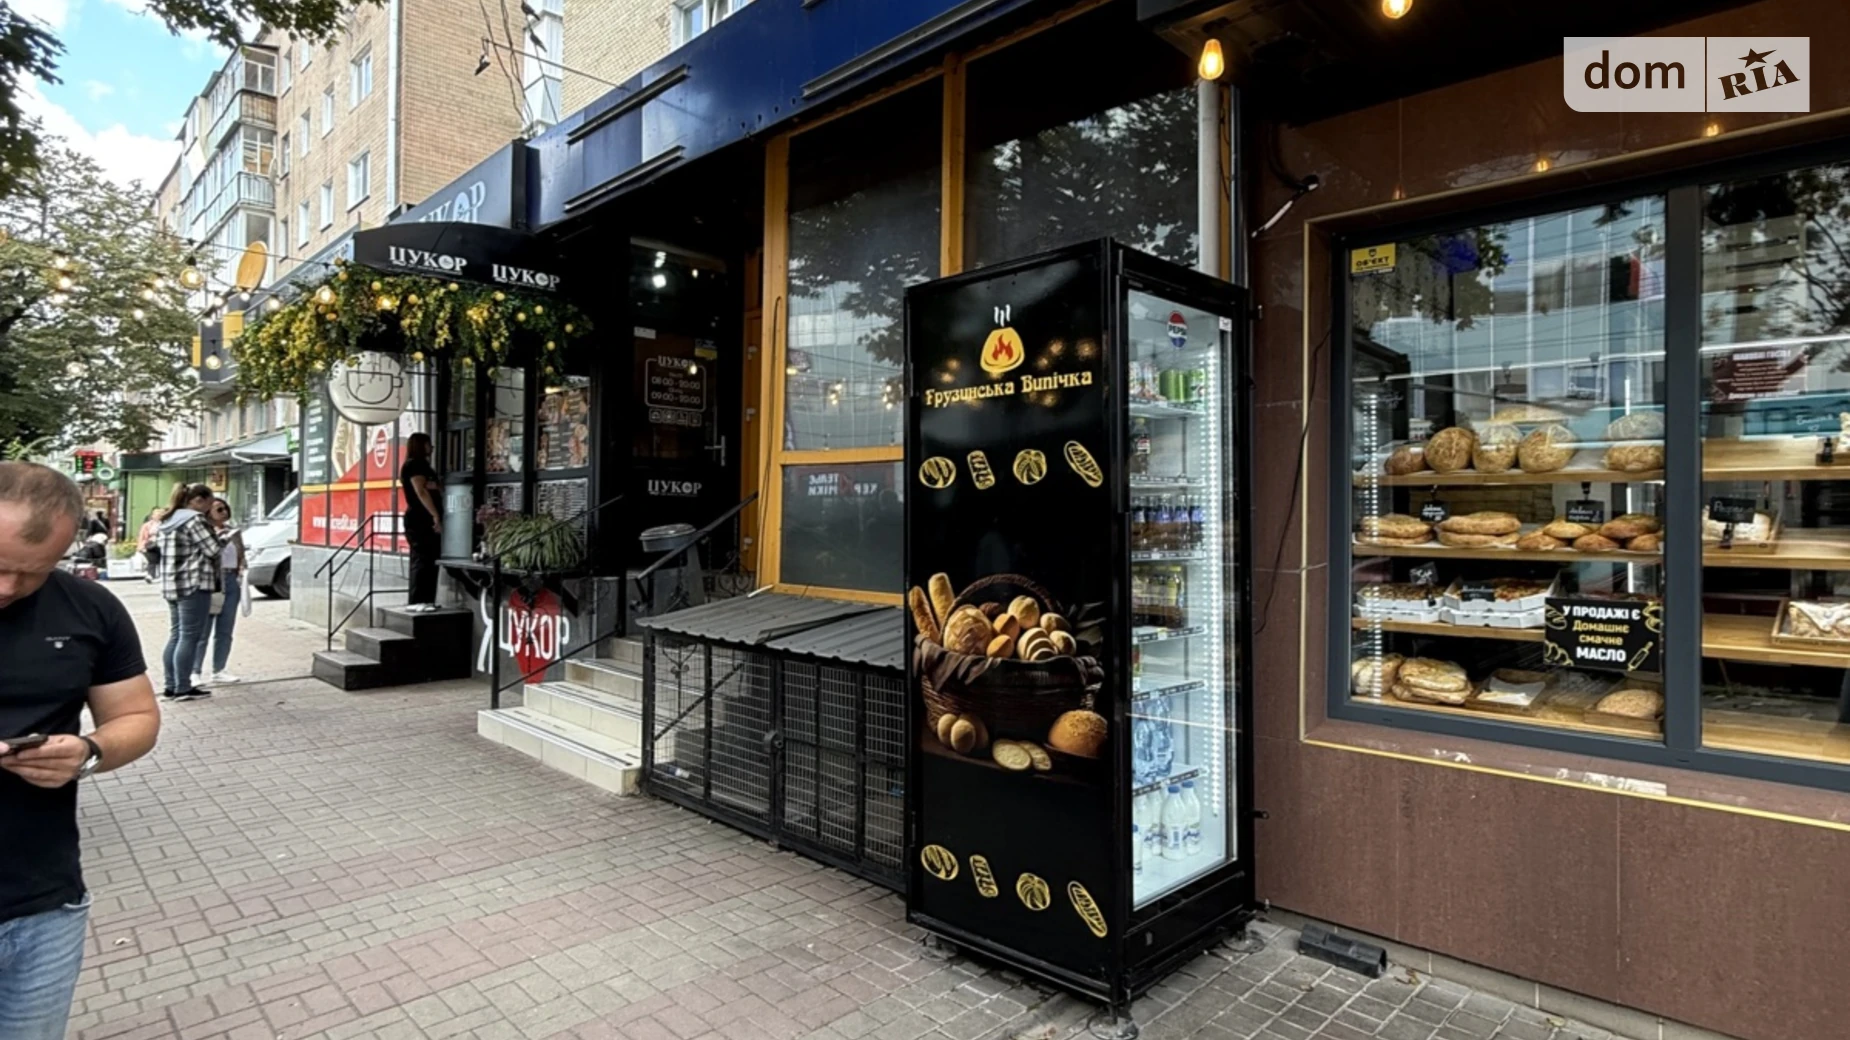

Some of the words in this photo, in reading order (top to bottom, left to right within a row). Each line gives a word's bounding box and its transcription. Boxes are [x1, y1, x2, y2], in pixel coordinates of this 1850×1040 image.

[389, 246, 467, 271] ЦУКОР
[492, 264, 560, 287] ЦУКОР
[925, 382, 1015, 408] Грузинська
[1021, 371, 1093, 393] Випічка
[647, 480, 702, 496] ЦУКОР
[1563, 606, 1571, 616] У
[1573, 606, 1629, 619] ПРОДАЖІ
[1631, 609, 1641, 620] Є
[499, 606, 569, 660] ЦУКОР
[1576, 647, 1627, 662] МАСЛО
